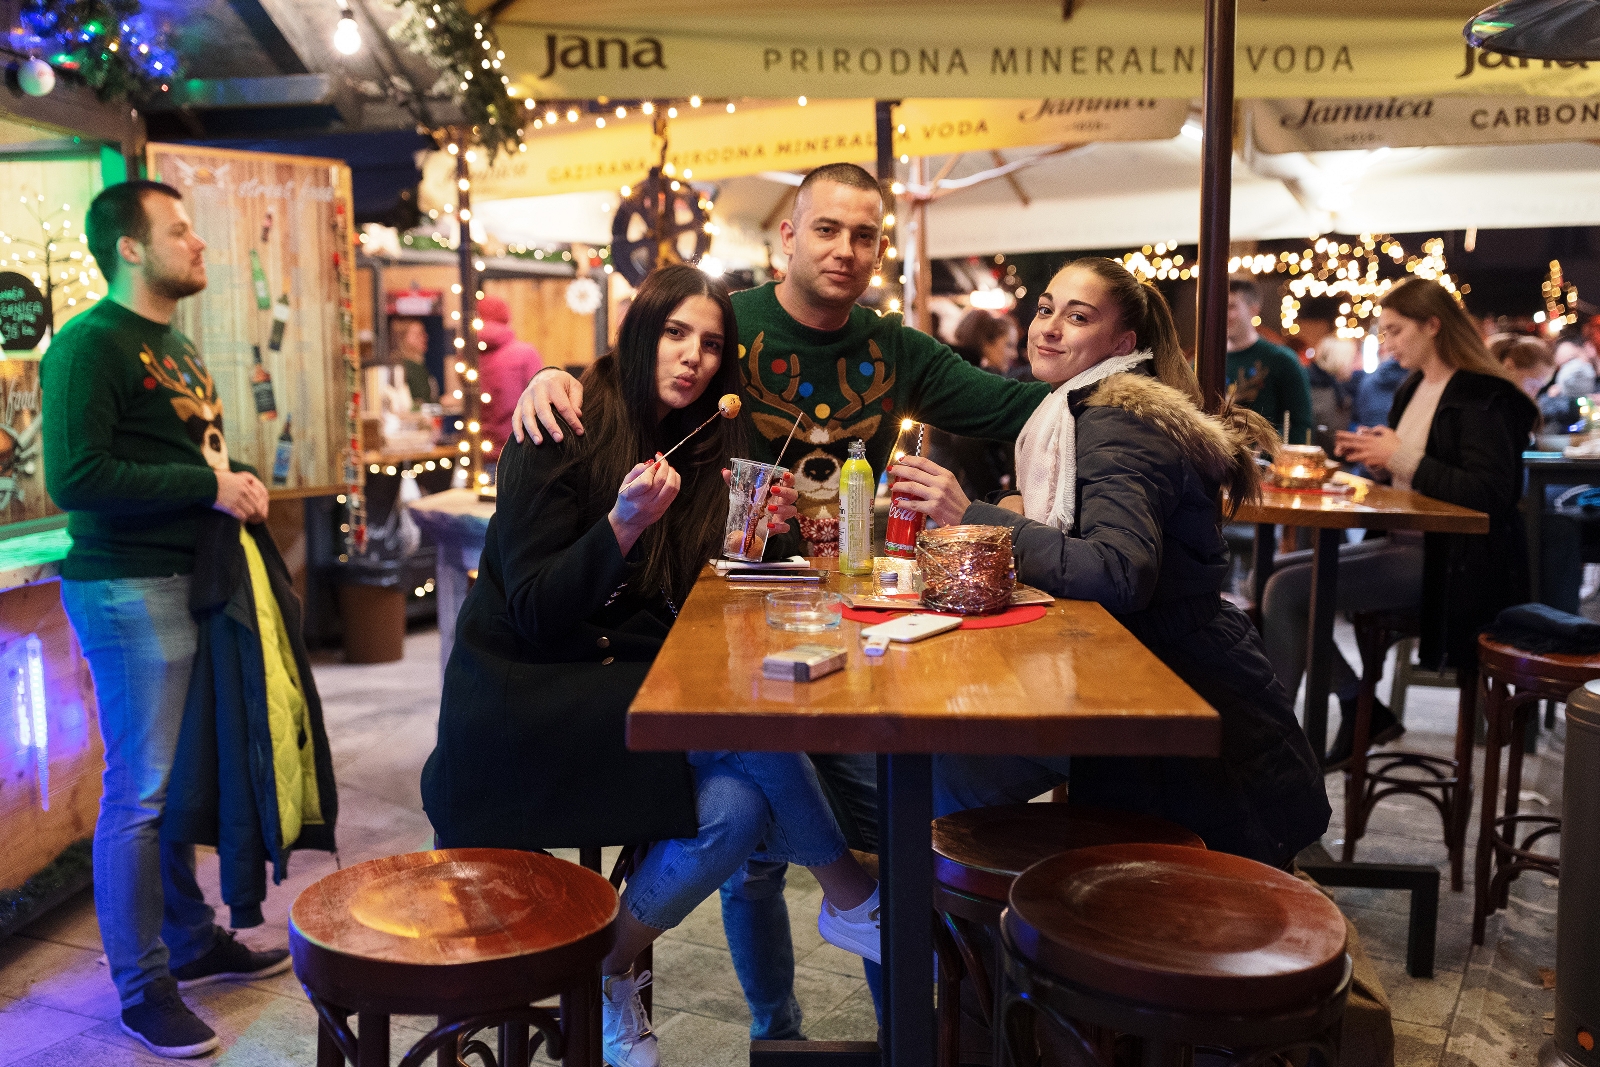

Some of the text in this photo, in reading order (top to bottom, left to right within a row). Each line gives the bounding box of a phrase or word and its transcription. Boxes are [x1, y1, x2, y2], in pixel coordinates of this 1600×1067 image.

[539, 33, 667, 79] Jana
[763, 44, 1354, 76] PRIRODNA MINERALN VODA
[1470, 102, 1600, 129] CARBON
[671, 143, 767, 167] RIRODNA
[775, 126, 911, 156] MINERALA
[921, 120, 988, 140] VODA
